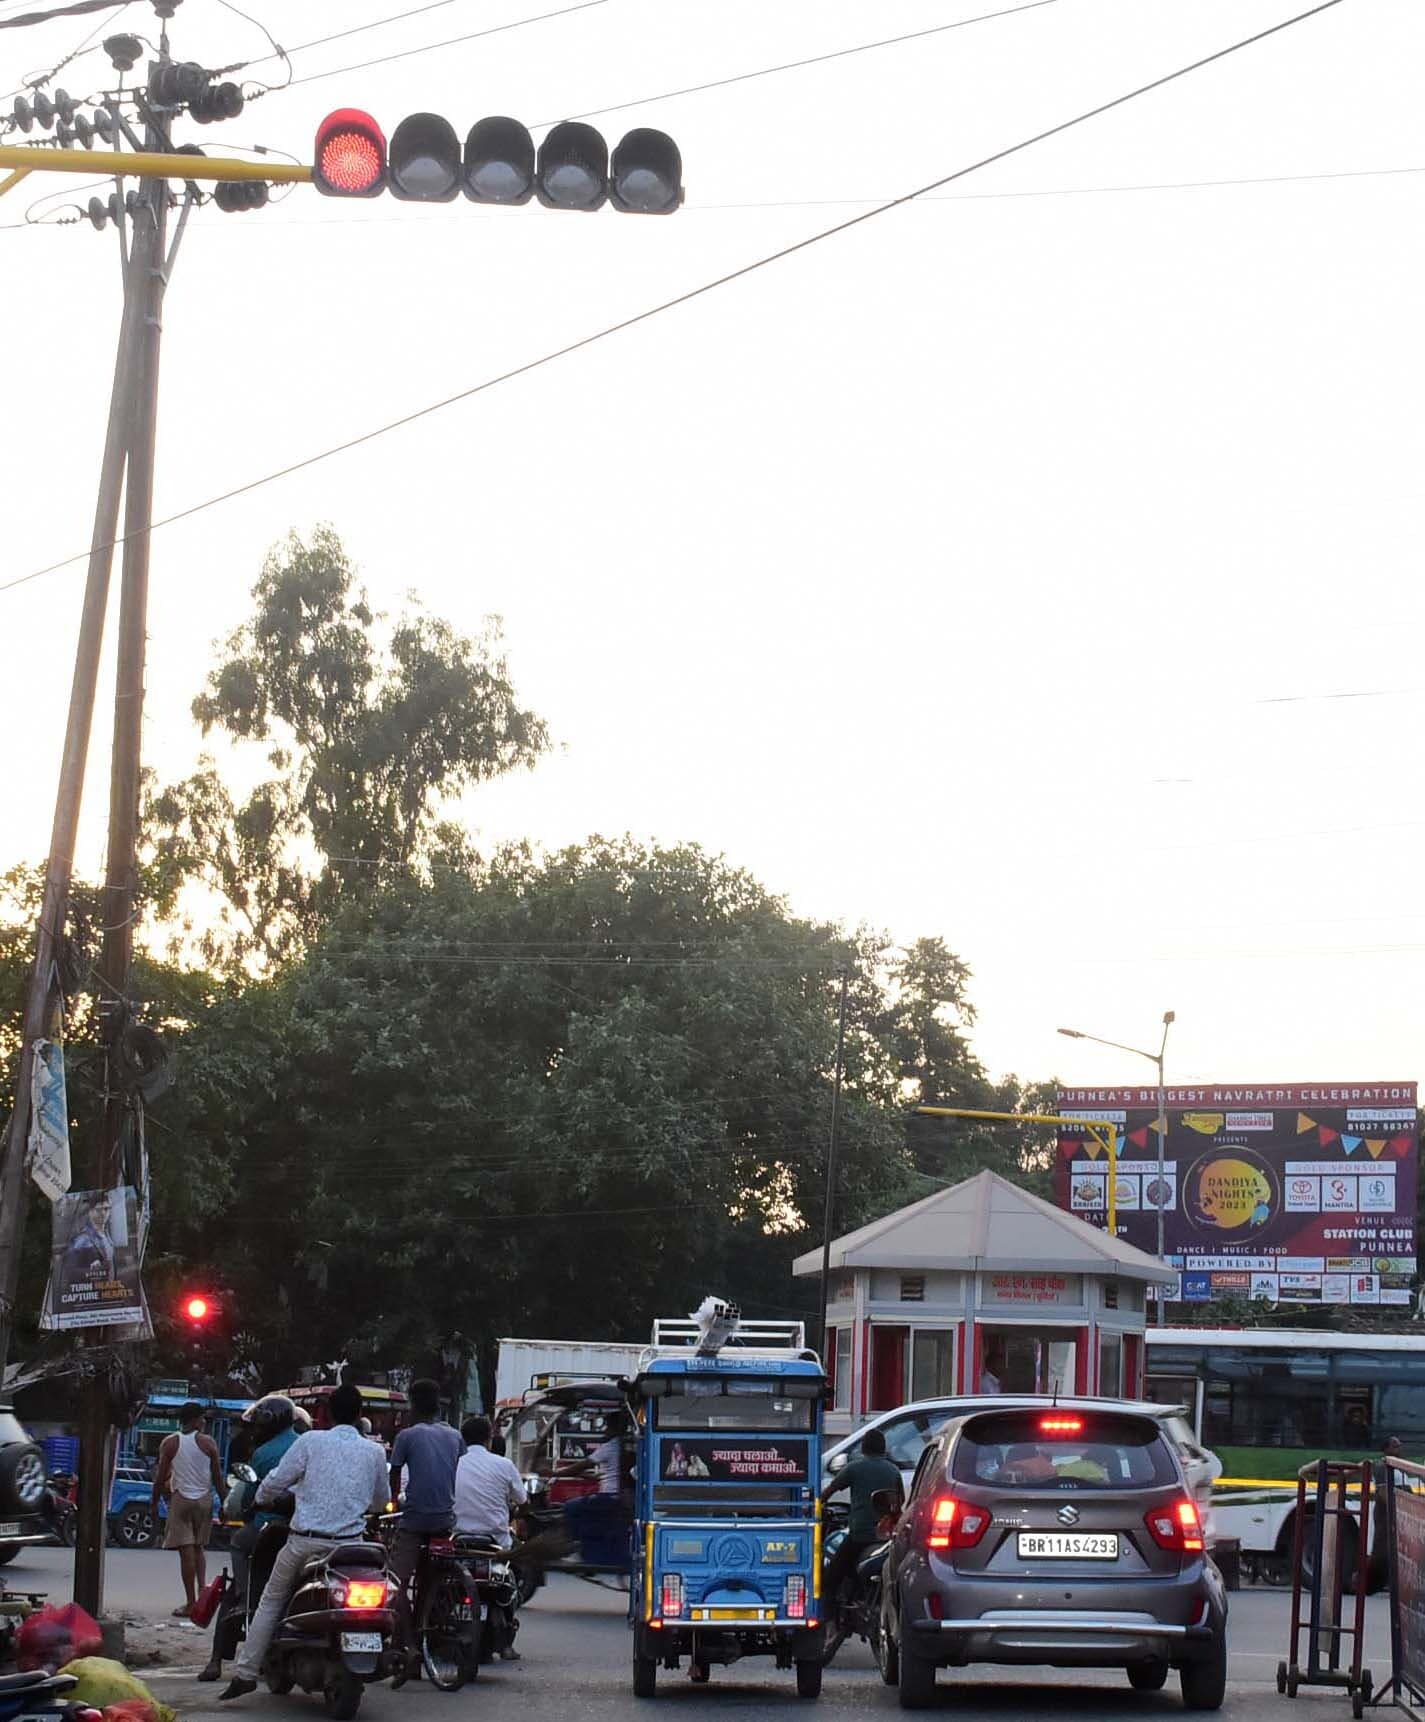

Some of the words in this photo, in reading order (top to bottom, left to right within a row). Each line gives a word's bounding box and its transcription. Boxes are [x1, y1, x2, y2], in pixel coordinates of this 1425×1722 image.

[1140, 1090, 1205, 1101] BIGEST
[1213, 1089, 1291, 1101] NAVRATRI
[1301, 1088, 1411, 1100] CELEBRATION
[1208, 1178, 1258, 1186] DANDIYA
[1211, 1189, 1254, 1198] NIGHTS
[1219, 1200, 1247, 1209] 2023
[1084, 1213, 1108, 1221] DAT
[1323, 1229, 1376, 1239] STATION
[1380, 1228, 1413, 1239] CLUB
[1360, 1242, 1413, 1252] PURNEA
[1189, 1259, 1251, 1267] POWERED
[1258, 1259, 1272, 1268] BY
[70, 1282, 93, 1293] TURN
[61, 1291, 99, 1303] CAPTURE
[1028, 1536, 1117, 1554] BR11AS4293
